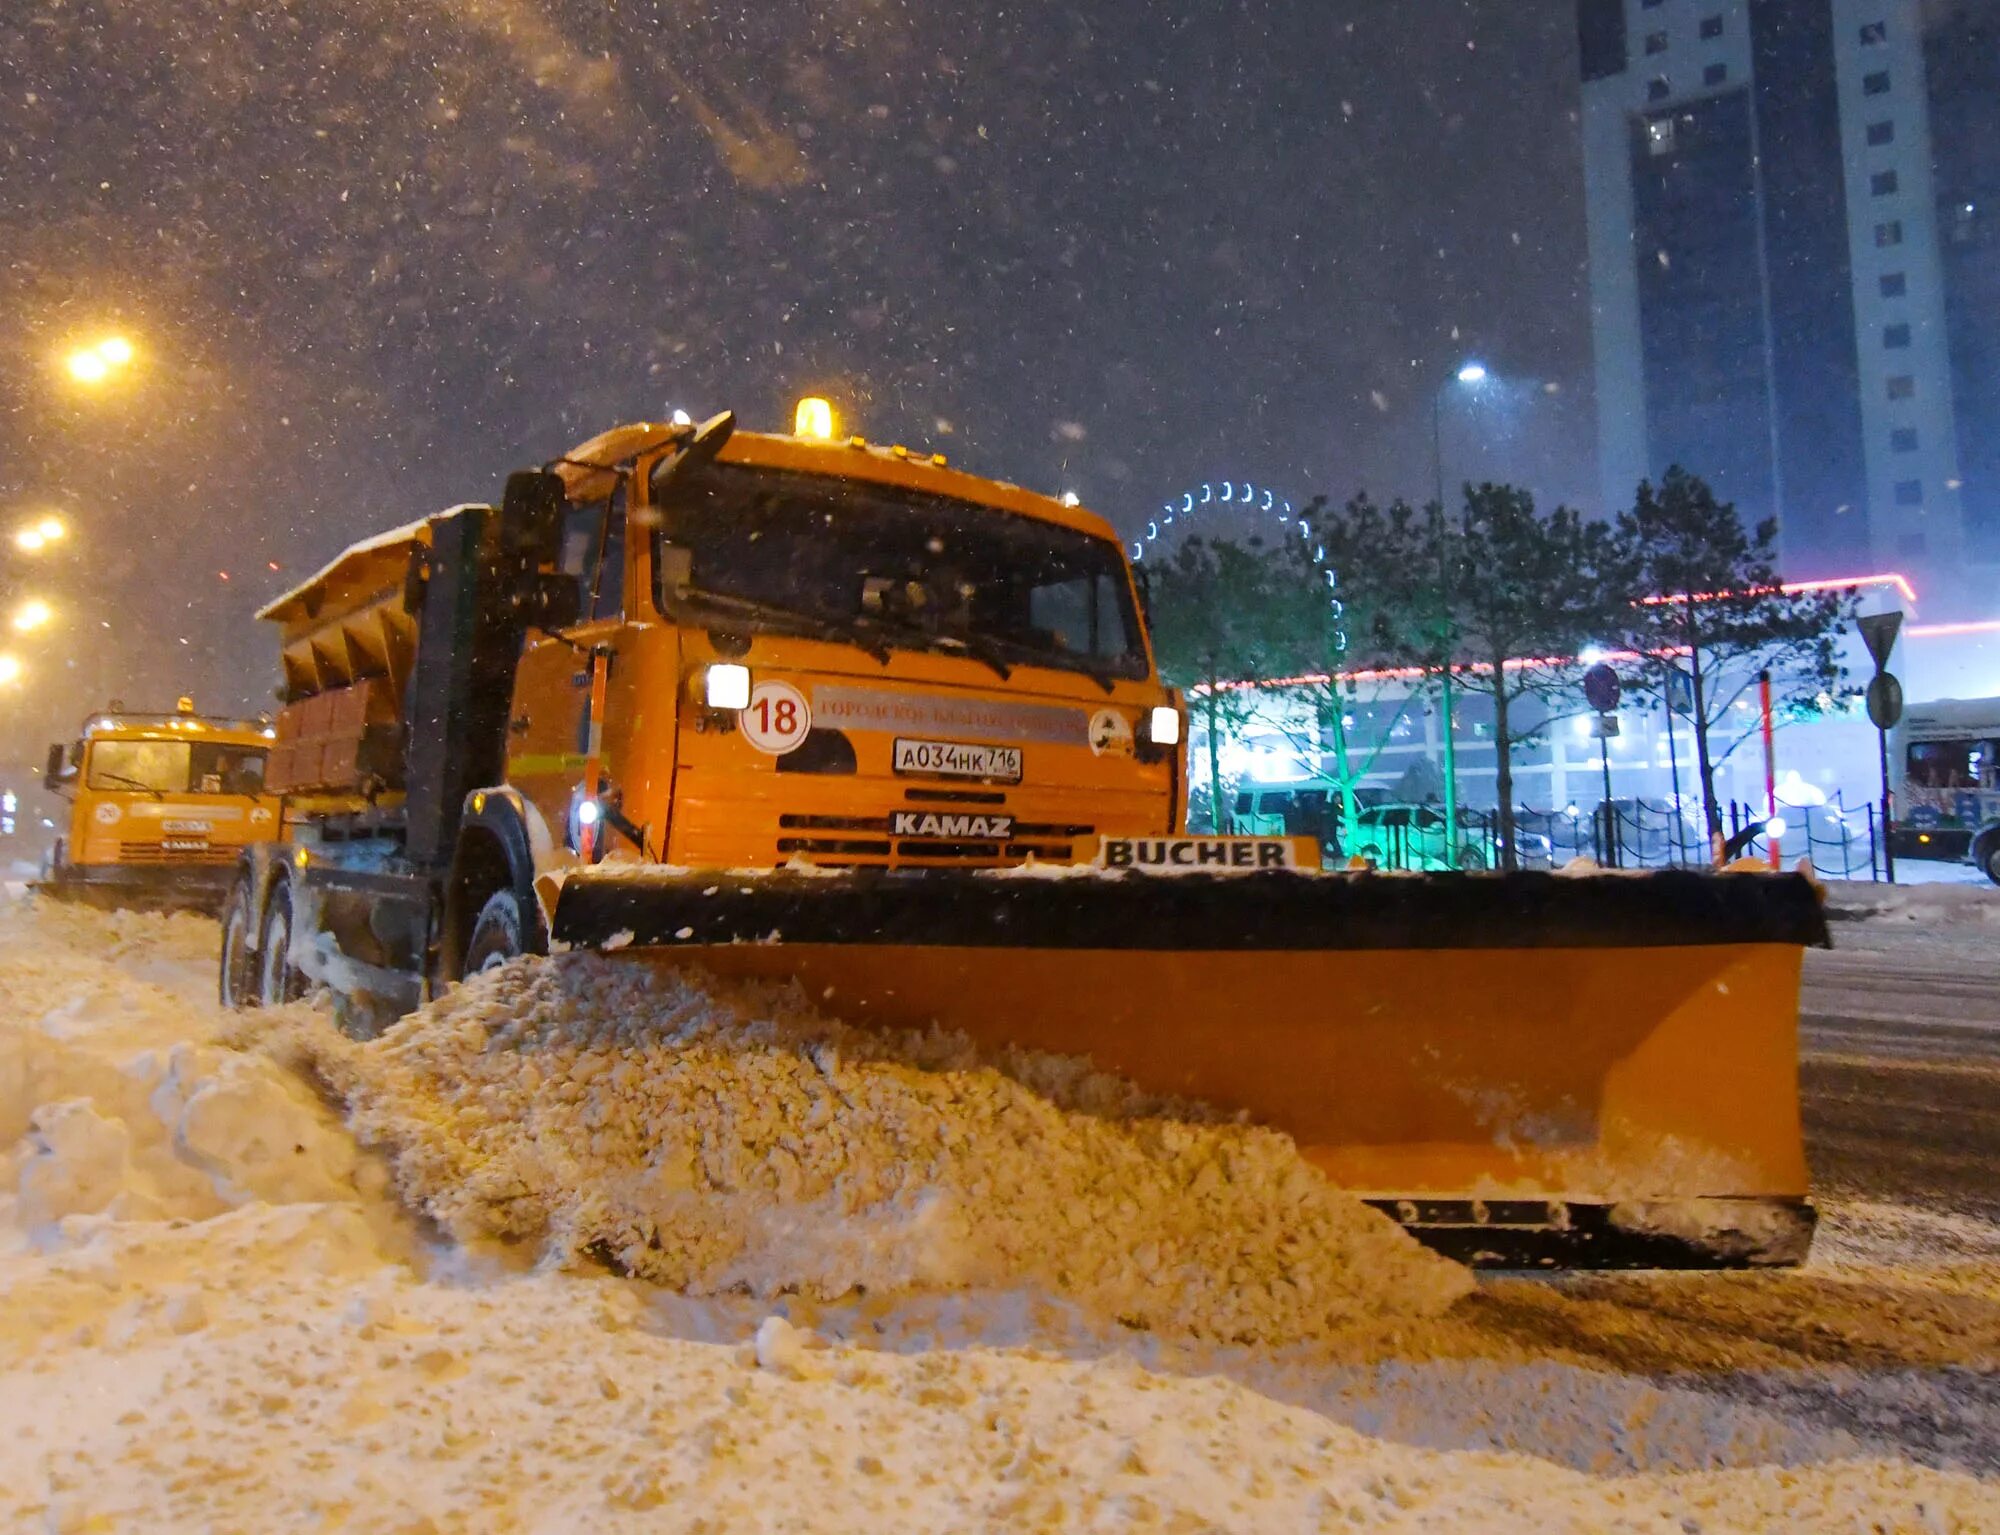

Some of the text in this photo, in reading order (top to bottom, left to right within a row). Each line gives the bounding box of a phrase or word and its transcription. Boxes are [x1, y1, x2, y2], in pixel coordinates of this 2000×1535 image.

[752, 697, 798, 736] 18
[895, 812, 1012, 838] KAMAZ
[1105, 840, 1286, 868] BUCHER
